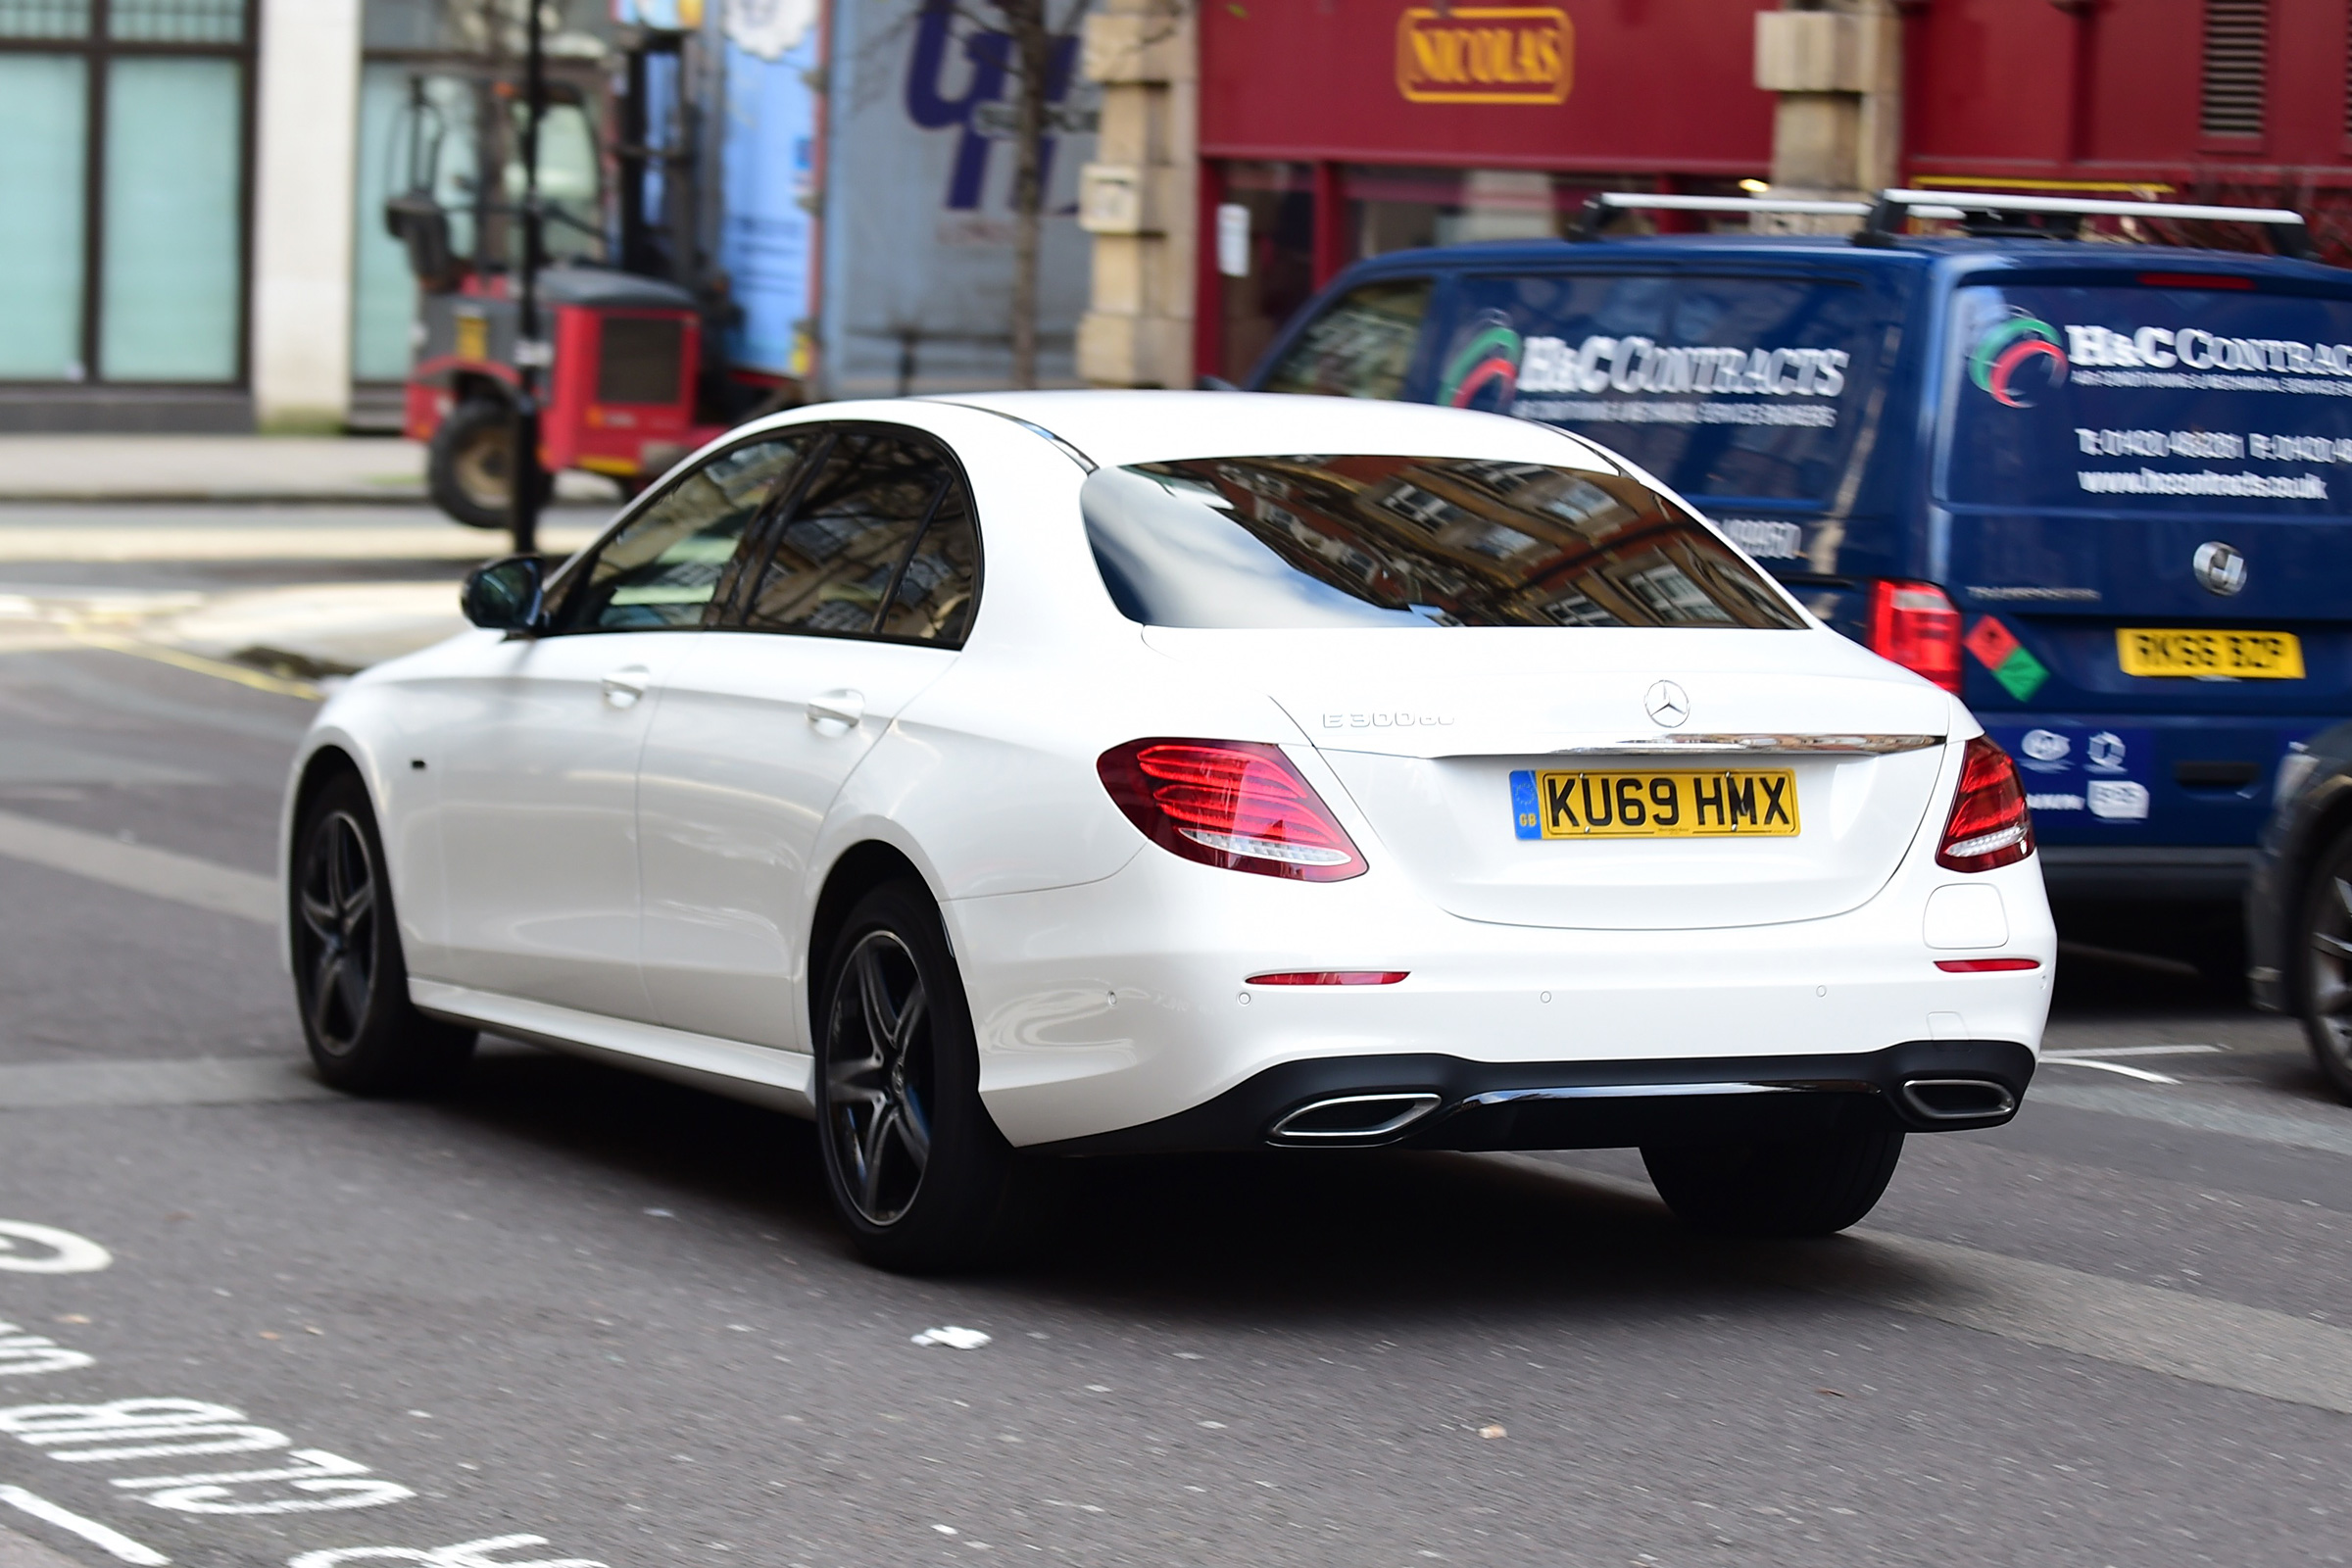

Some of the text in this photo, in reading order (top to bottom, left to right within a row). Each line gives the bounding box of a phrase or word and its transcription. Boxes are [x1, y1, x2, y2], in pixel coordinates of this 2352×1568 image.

[1409, 27, 1563, 84] NICOLAS
[1519, 813, 1538, 827] GB
[1547, 777, 1790, 827] KU69 HMX
